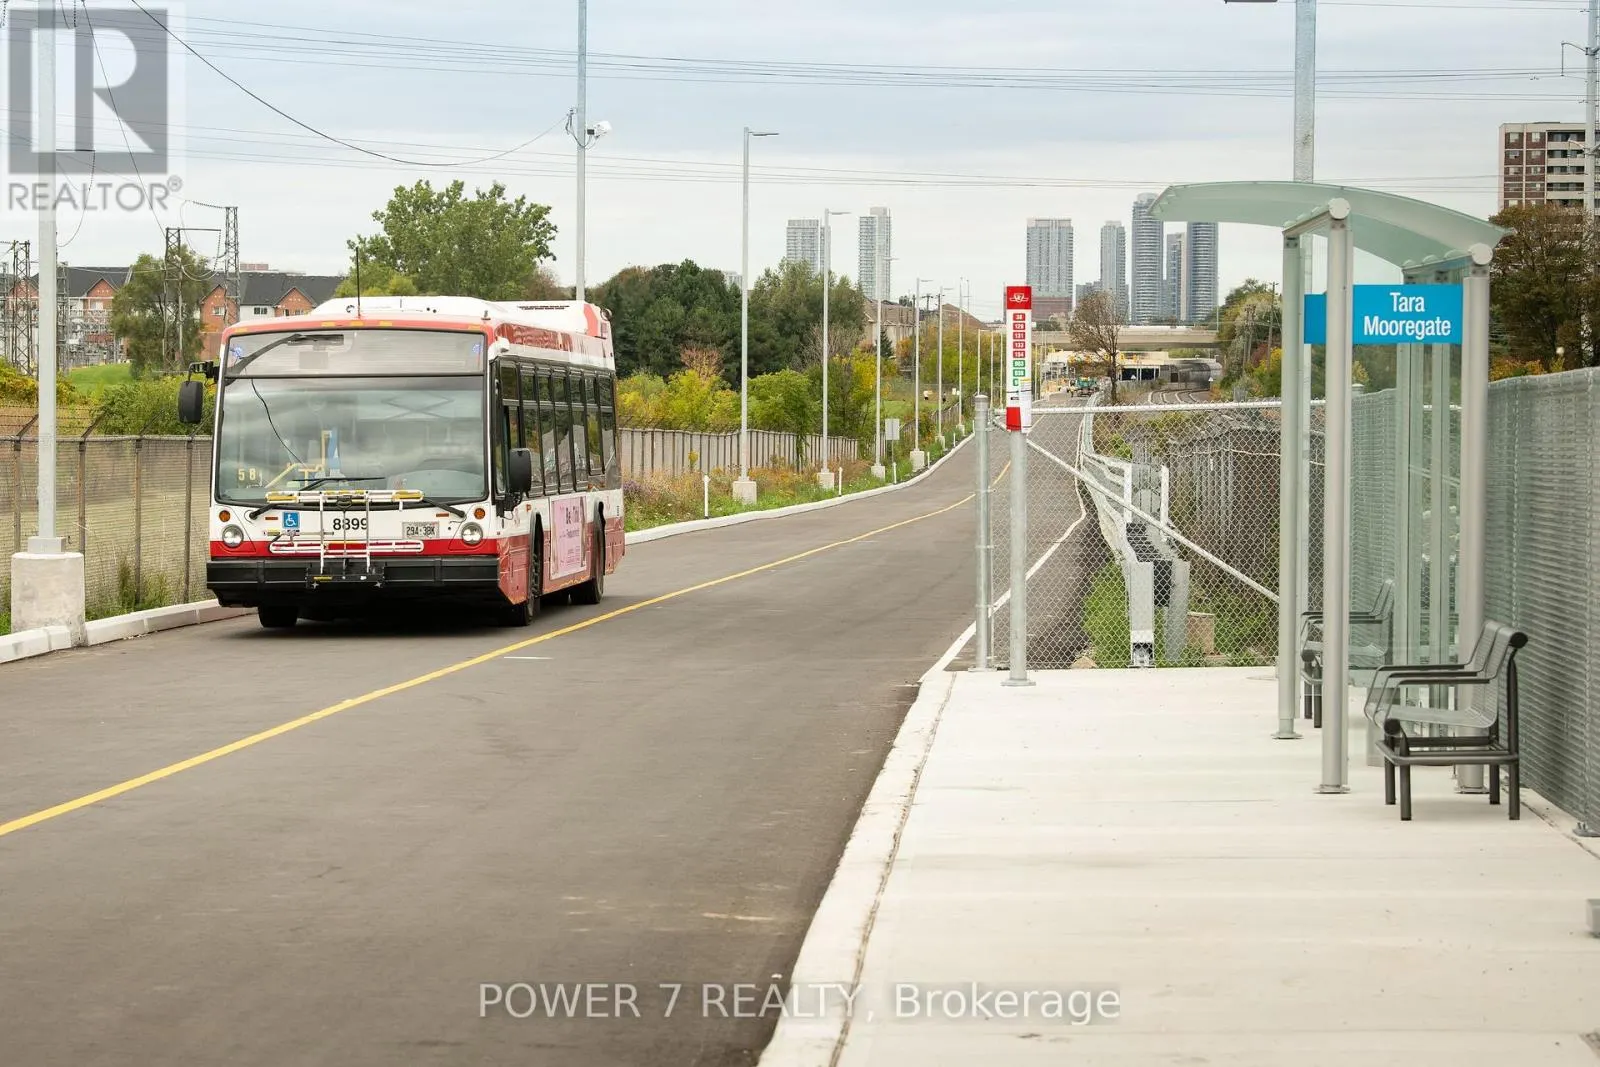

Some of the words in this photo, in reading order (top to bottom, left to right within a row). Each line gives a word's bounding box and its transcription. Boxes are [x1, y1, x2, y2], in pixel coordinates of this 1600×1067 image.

[1389, 292, 1425, 312] Tara
[1363, 315, 1451, 340] Mooregate
[333, 518, 367, 530] 8899
